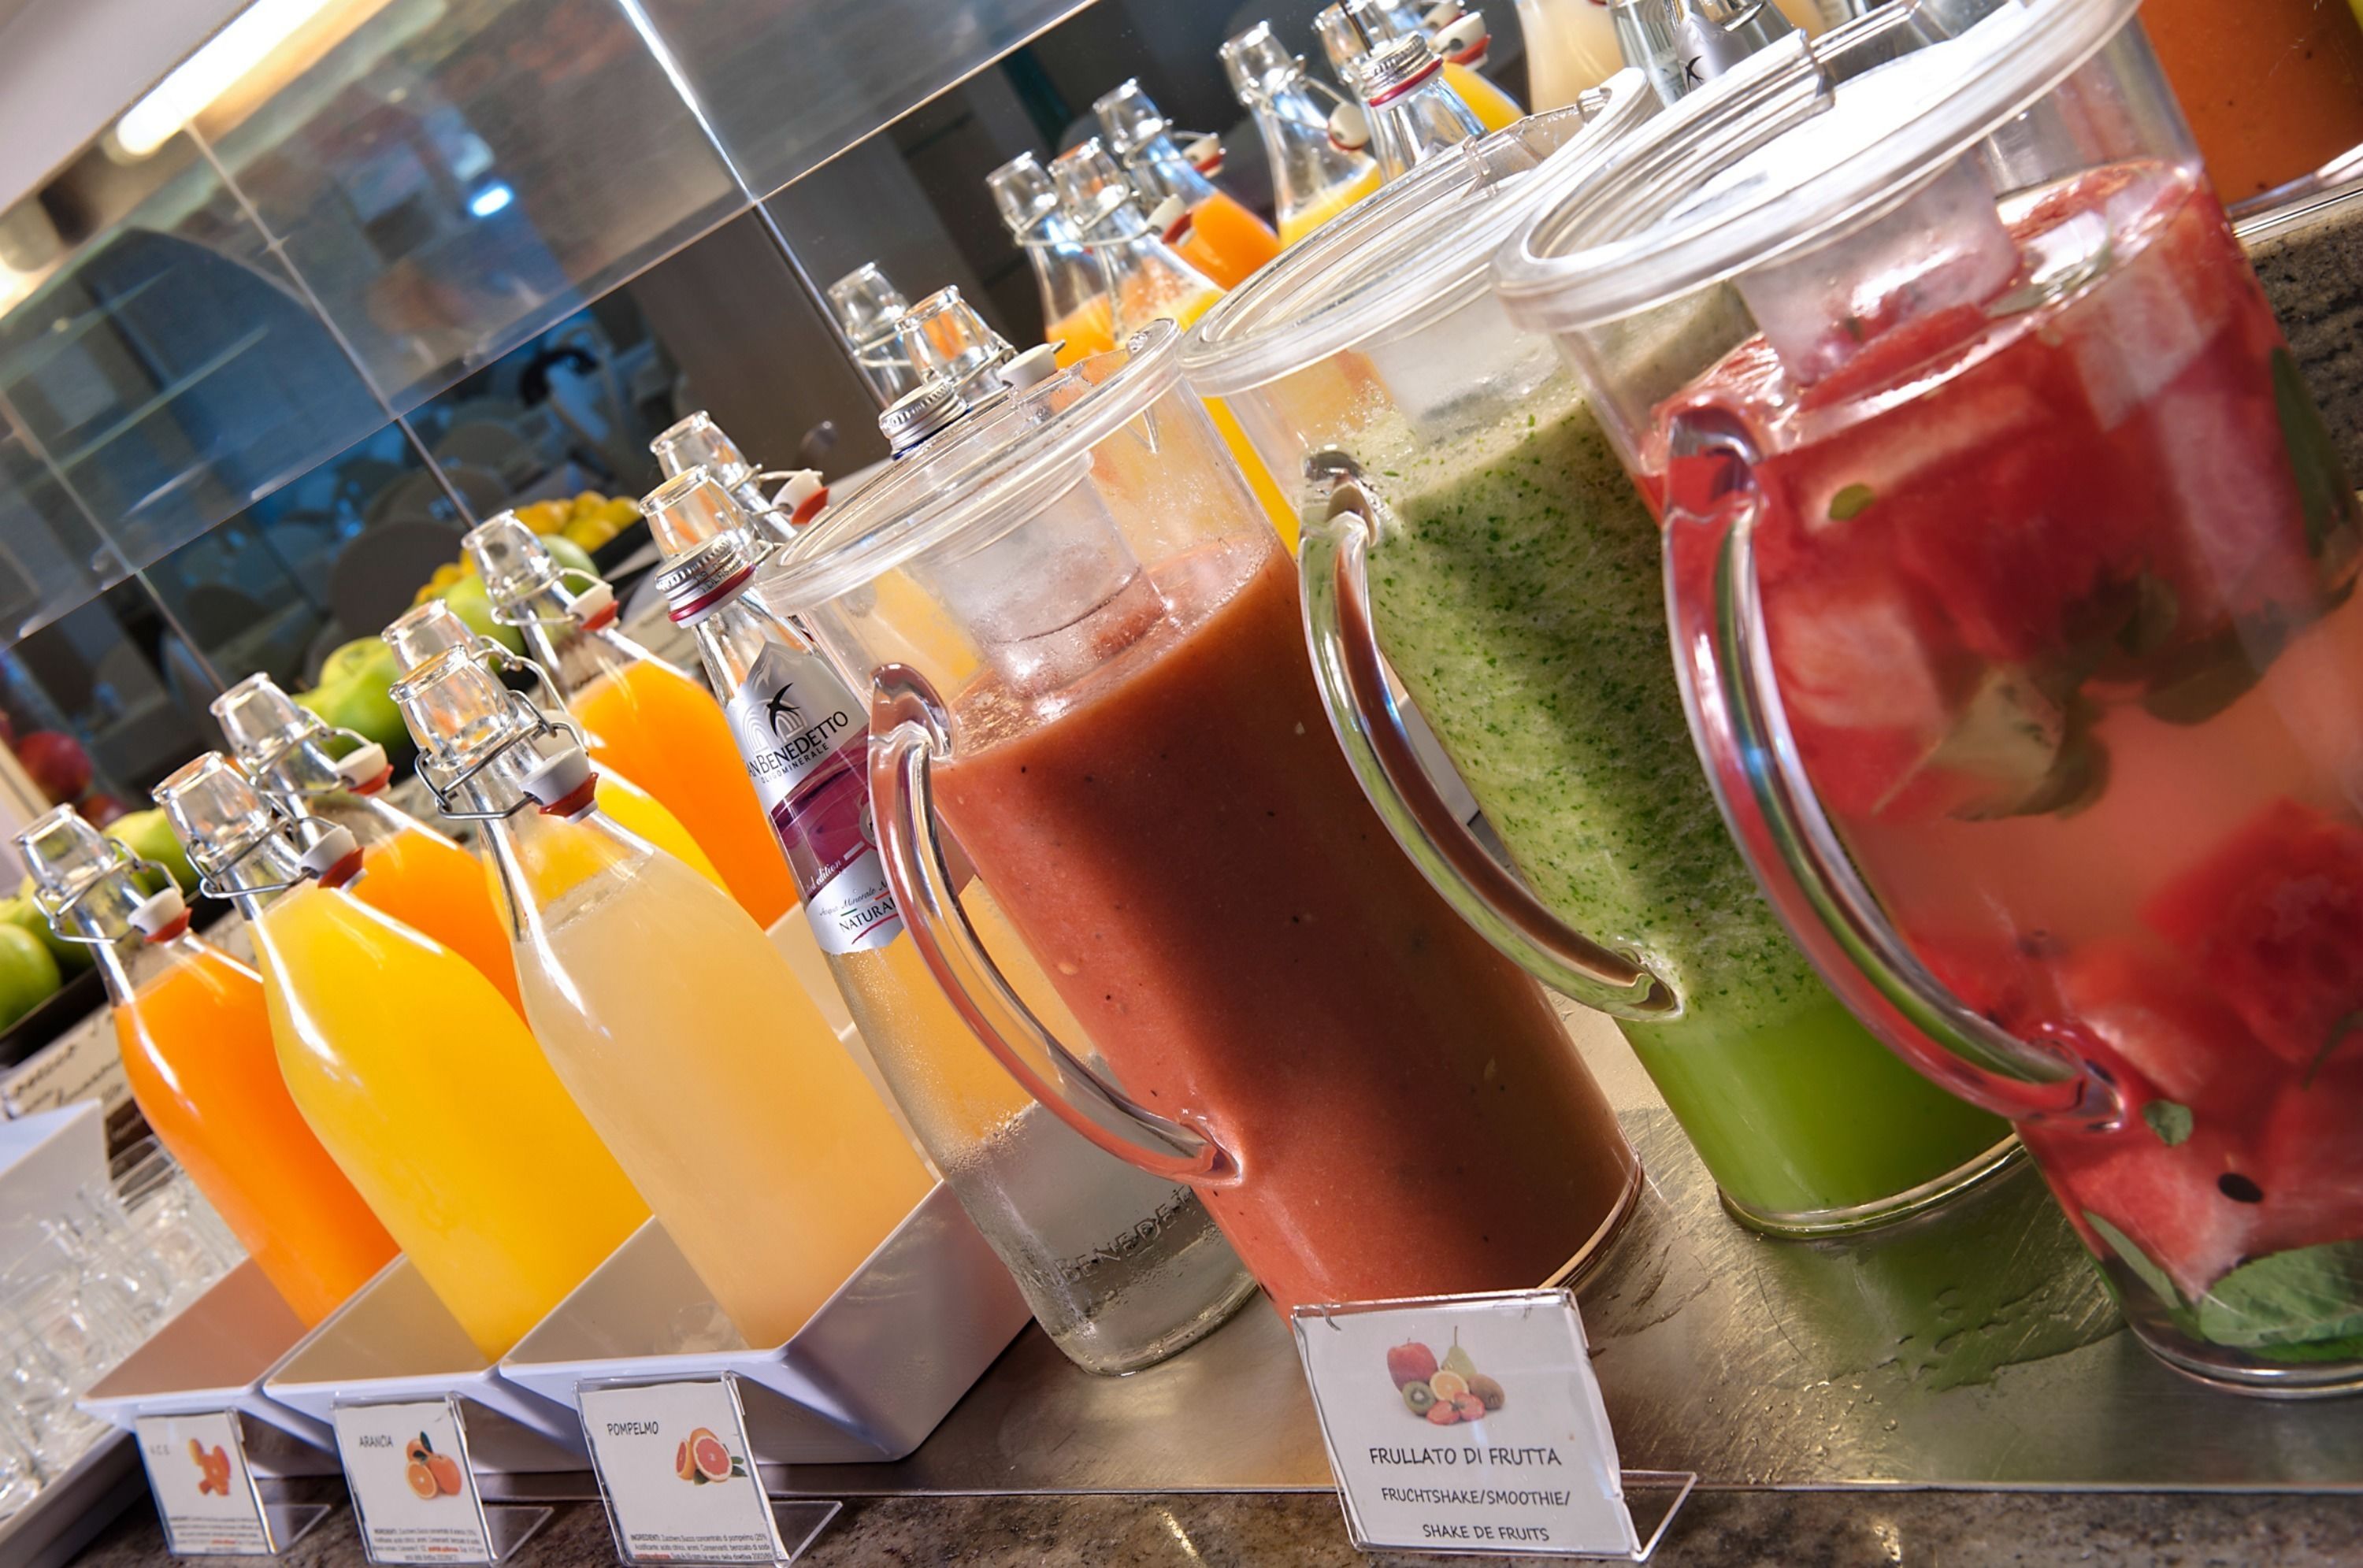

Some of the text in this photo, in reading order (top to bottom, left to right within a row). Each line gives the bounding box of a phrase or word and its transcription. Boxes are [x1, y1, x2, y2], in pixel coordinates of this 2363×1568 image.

[744, 711, 848, 777] AN BENEDETTO
[761, 743, 829, 784] OLIGOMINERALE
[607, 1421, 659, 1436] POMPELMO
[1369, 1447, 1562, 1466] FRULLATO DI FRUTTA
[1382, 1487, 1571, 1506] FRUCHTSHAKE/SMOOTHIE/
[1423, 1524, 1549, 1541] SHAKE DE FRUITS
